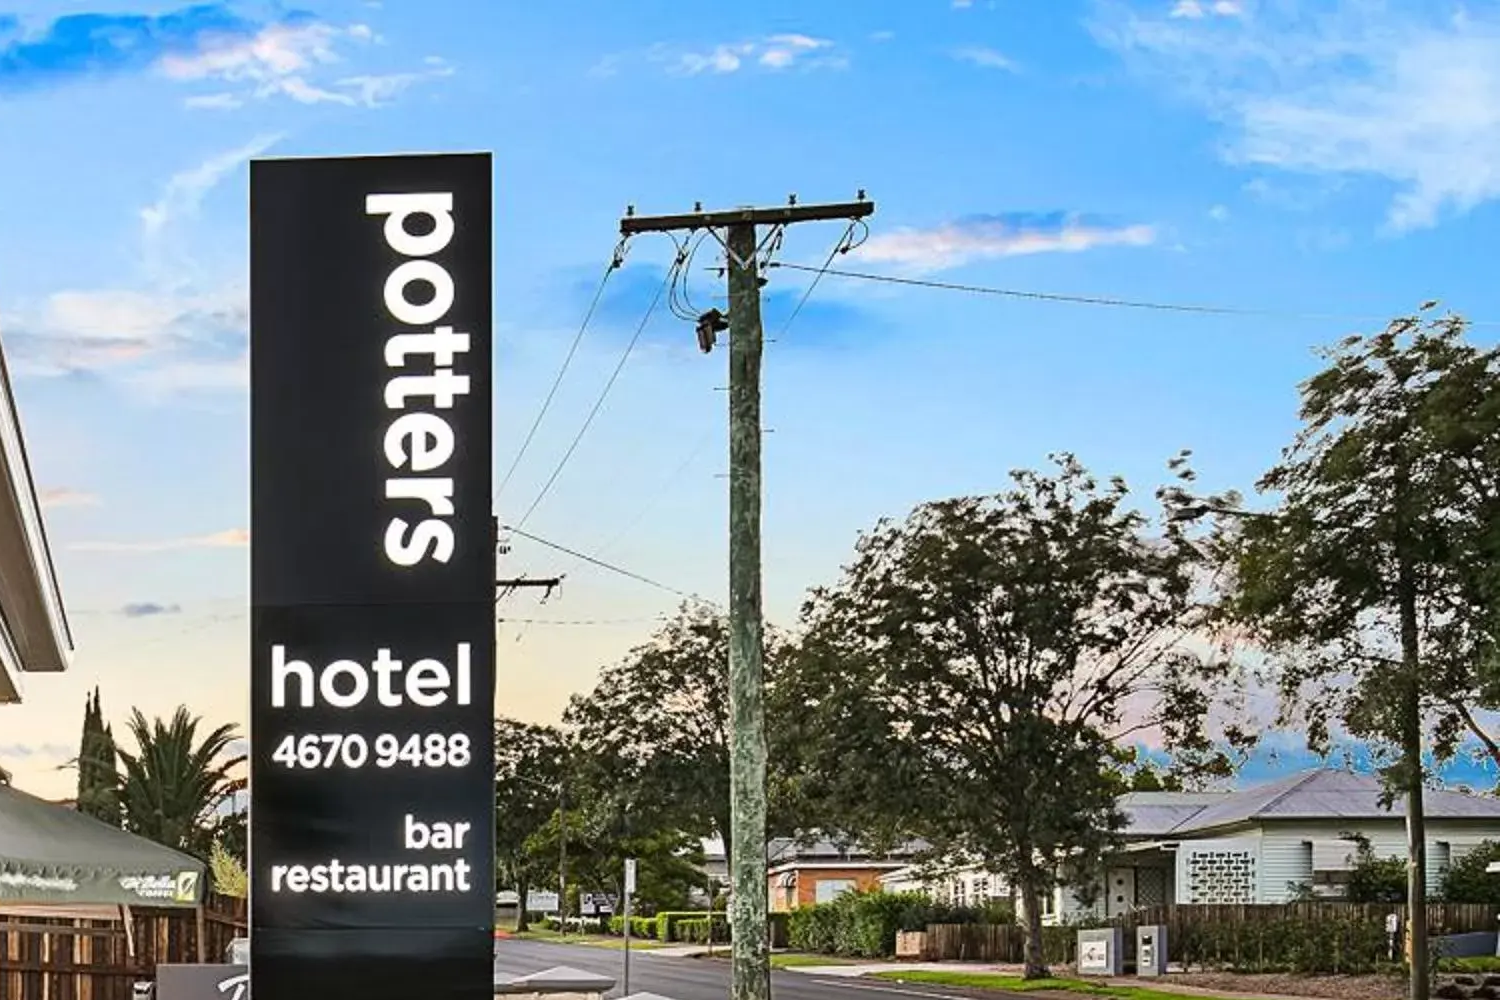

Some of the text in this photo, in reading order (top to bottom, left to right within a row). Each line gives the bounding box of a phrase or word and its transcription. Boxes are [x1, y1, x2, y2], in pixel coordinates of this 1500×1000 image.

[365, 191, 471, 567] potters
[271, 642, 471, 708] hotel
[271, 732, 471, 769] 4670 9488
[404, 813, 471, 850] bar
[271, 858, 471, 893] restaurant
